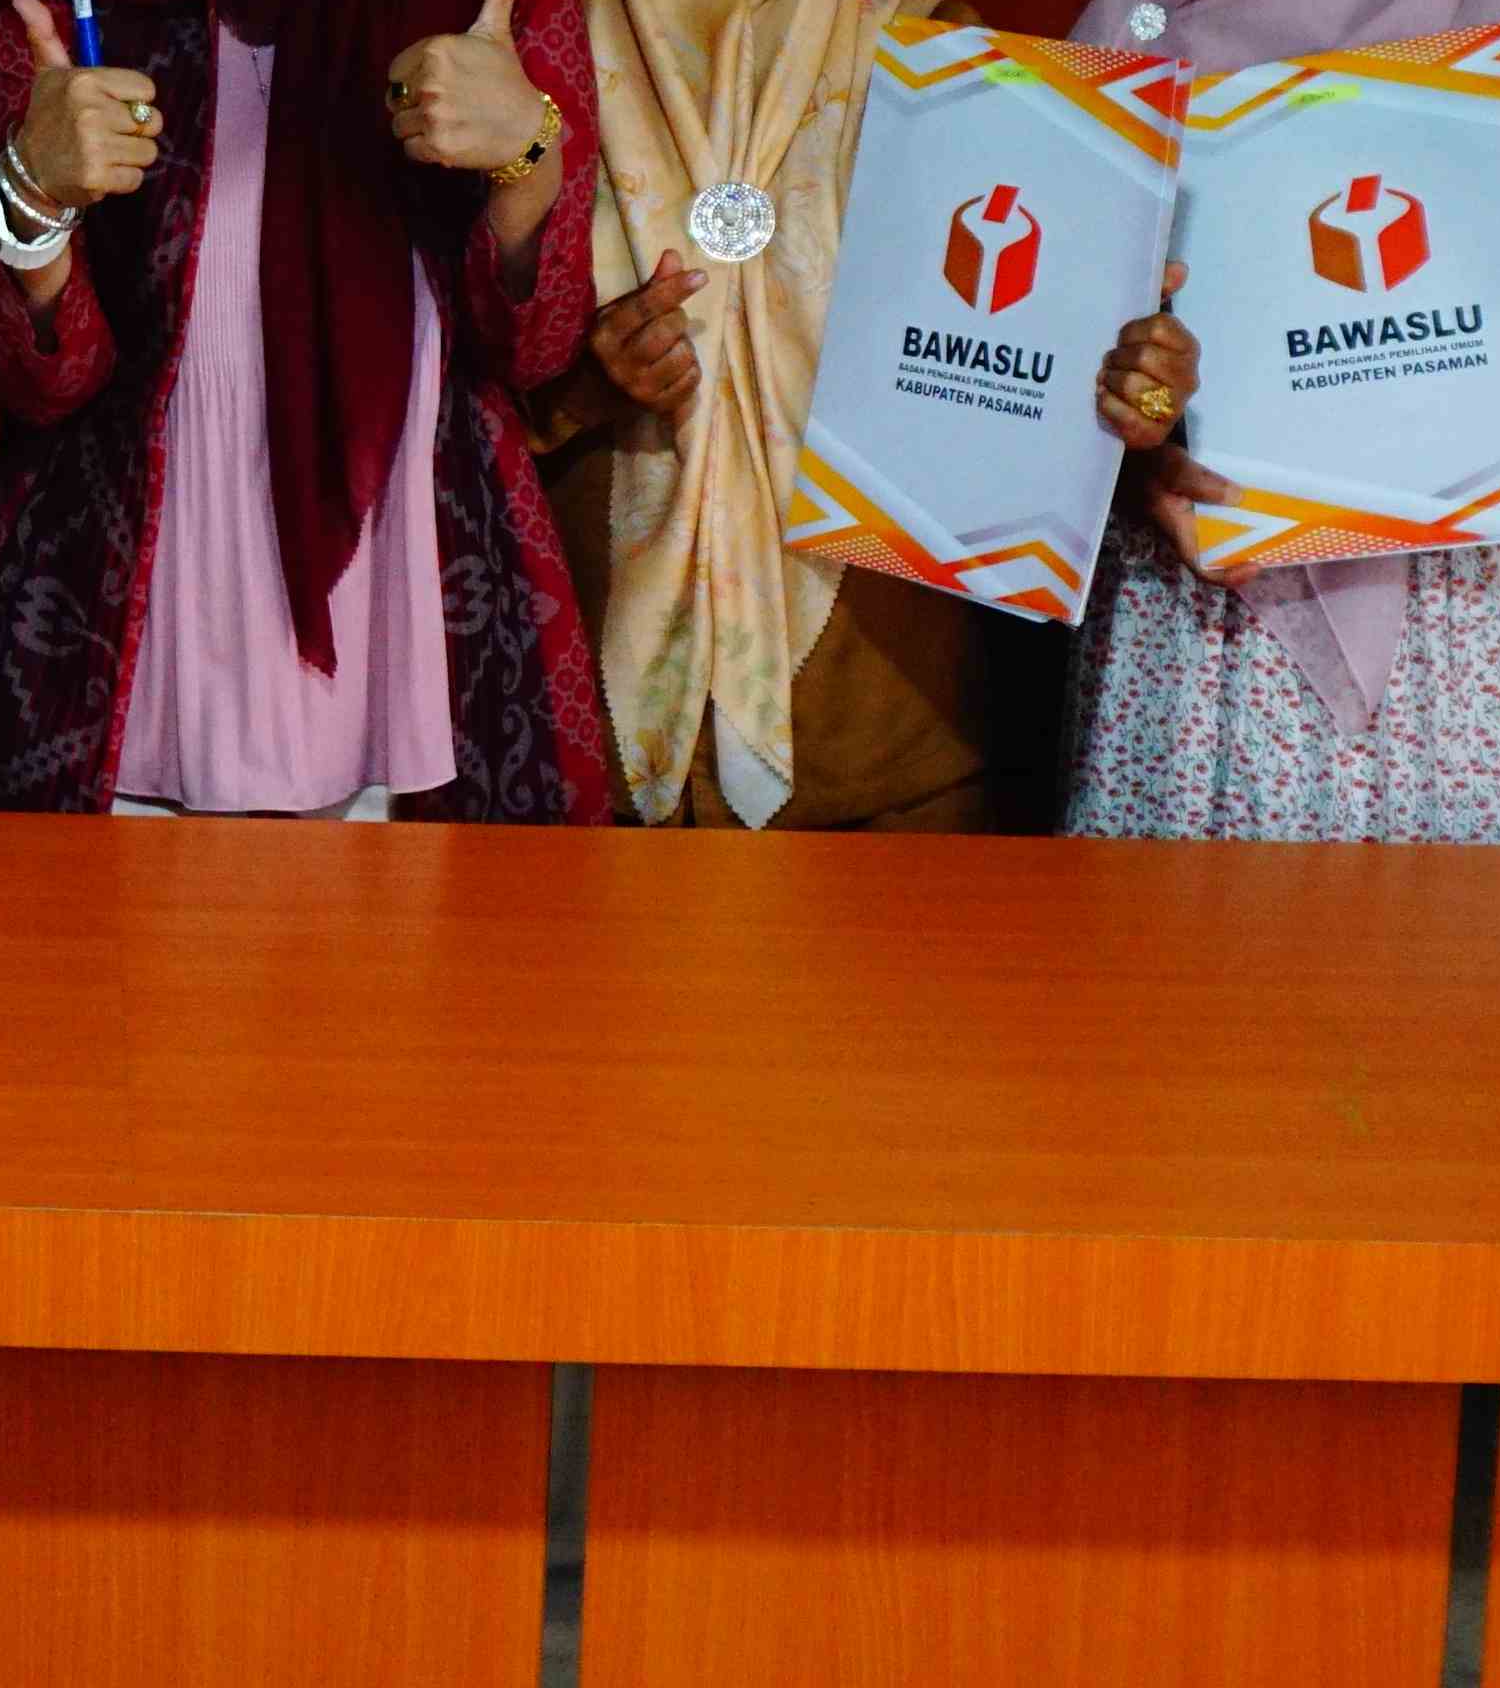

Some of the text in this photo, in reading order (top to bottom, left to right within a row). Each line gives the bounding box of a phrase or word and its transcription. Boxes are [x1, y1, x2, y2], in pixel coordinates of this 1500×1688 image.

[1286, 304, 1483, 358] BAWASLU
[903, 326, 1054, 383] BAWASLU
[1289, 362, 1324, 373] BADAN
[1328, 354, 1386, 368] PENGAWAS
[1389, 345, 1447, 359] PEMILIHAN
[1291, 353, 1488, 392] KABUPATEN PASAMAN
[896, 377, 1043, 420] KABUPATEN PASAMAN
